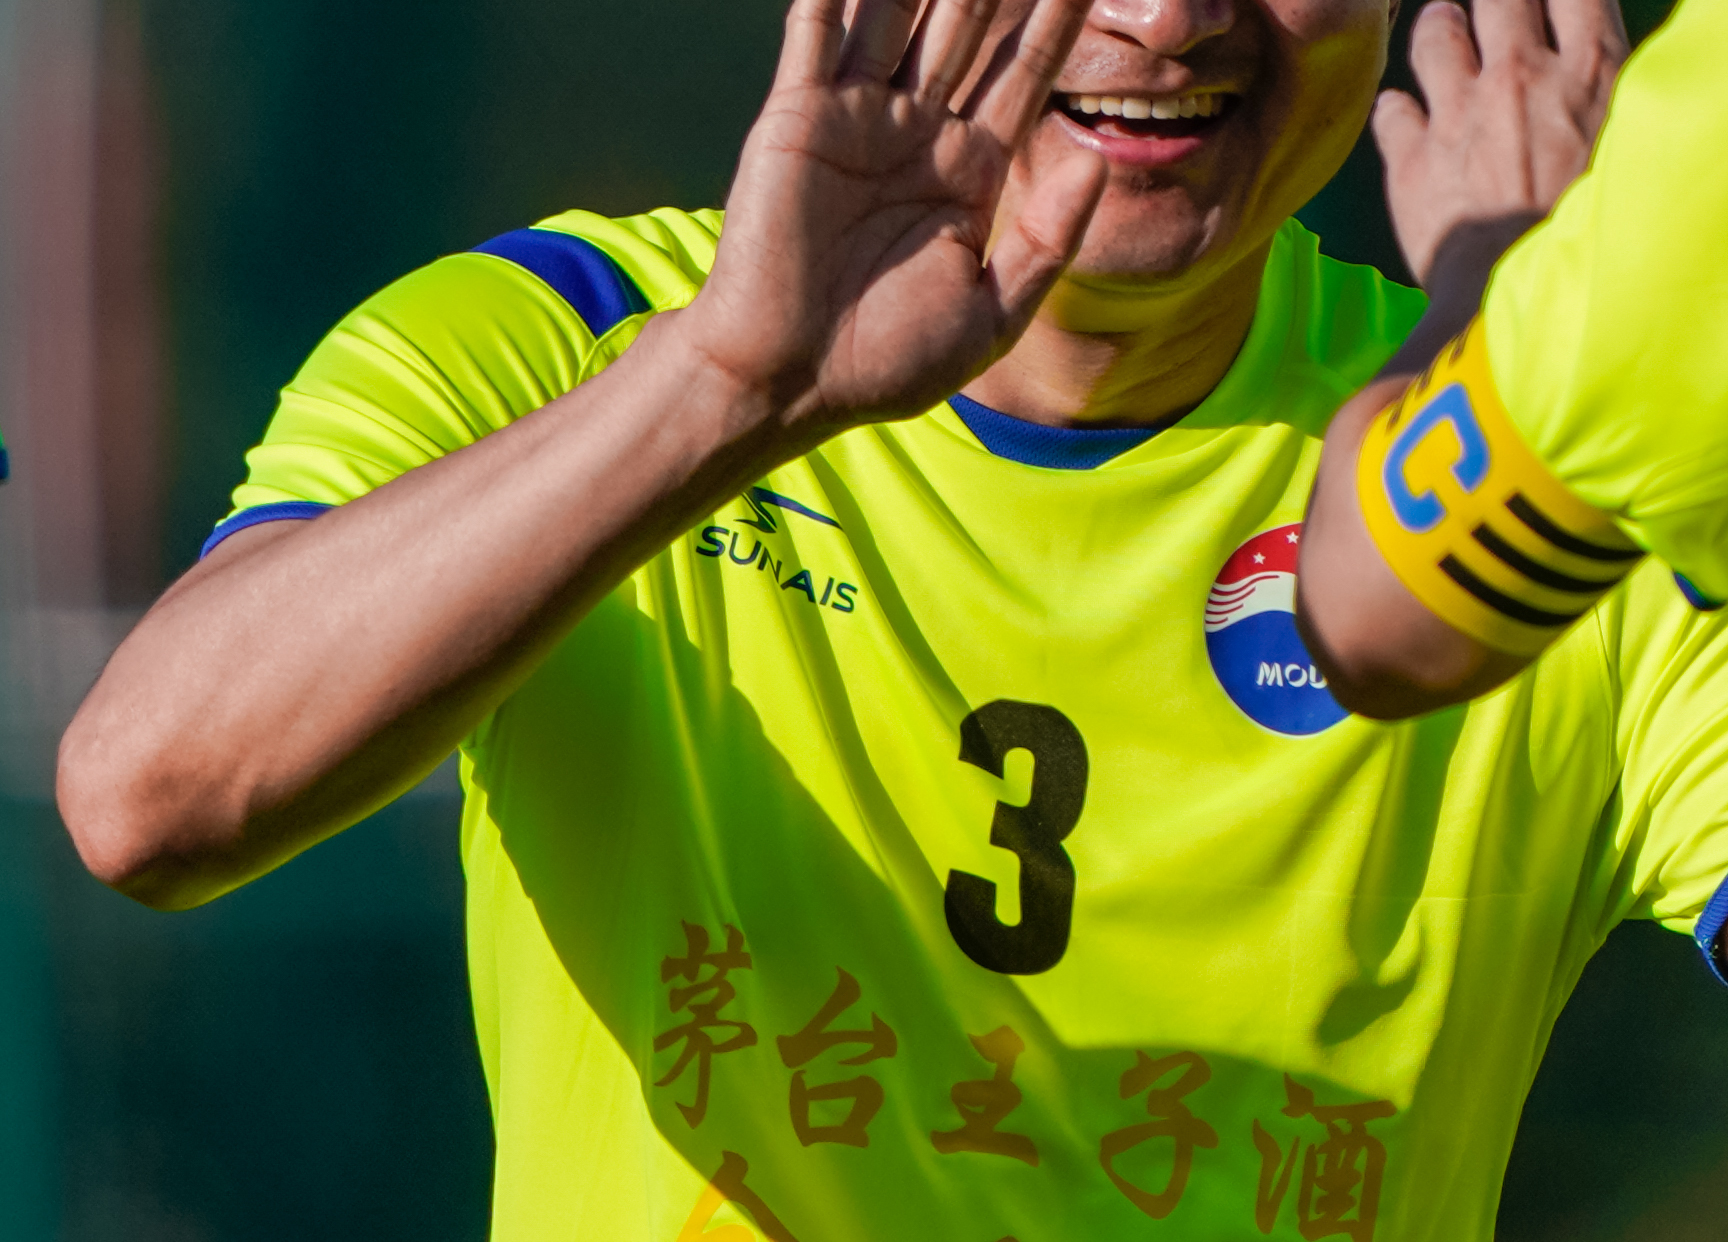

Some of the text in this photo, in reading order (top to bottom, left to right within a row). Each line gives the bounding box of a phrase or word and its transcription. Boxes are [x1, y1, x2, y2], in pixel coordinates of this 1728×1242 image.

[1382, 381, 1492, 534] C
[695, 525, 859, 614] SUNAIS
[943, 698, 1090, 976] 3
[653, 920, 1399, 1240] 茅台王子酒
